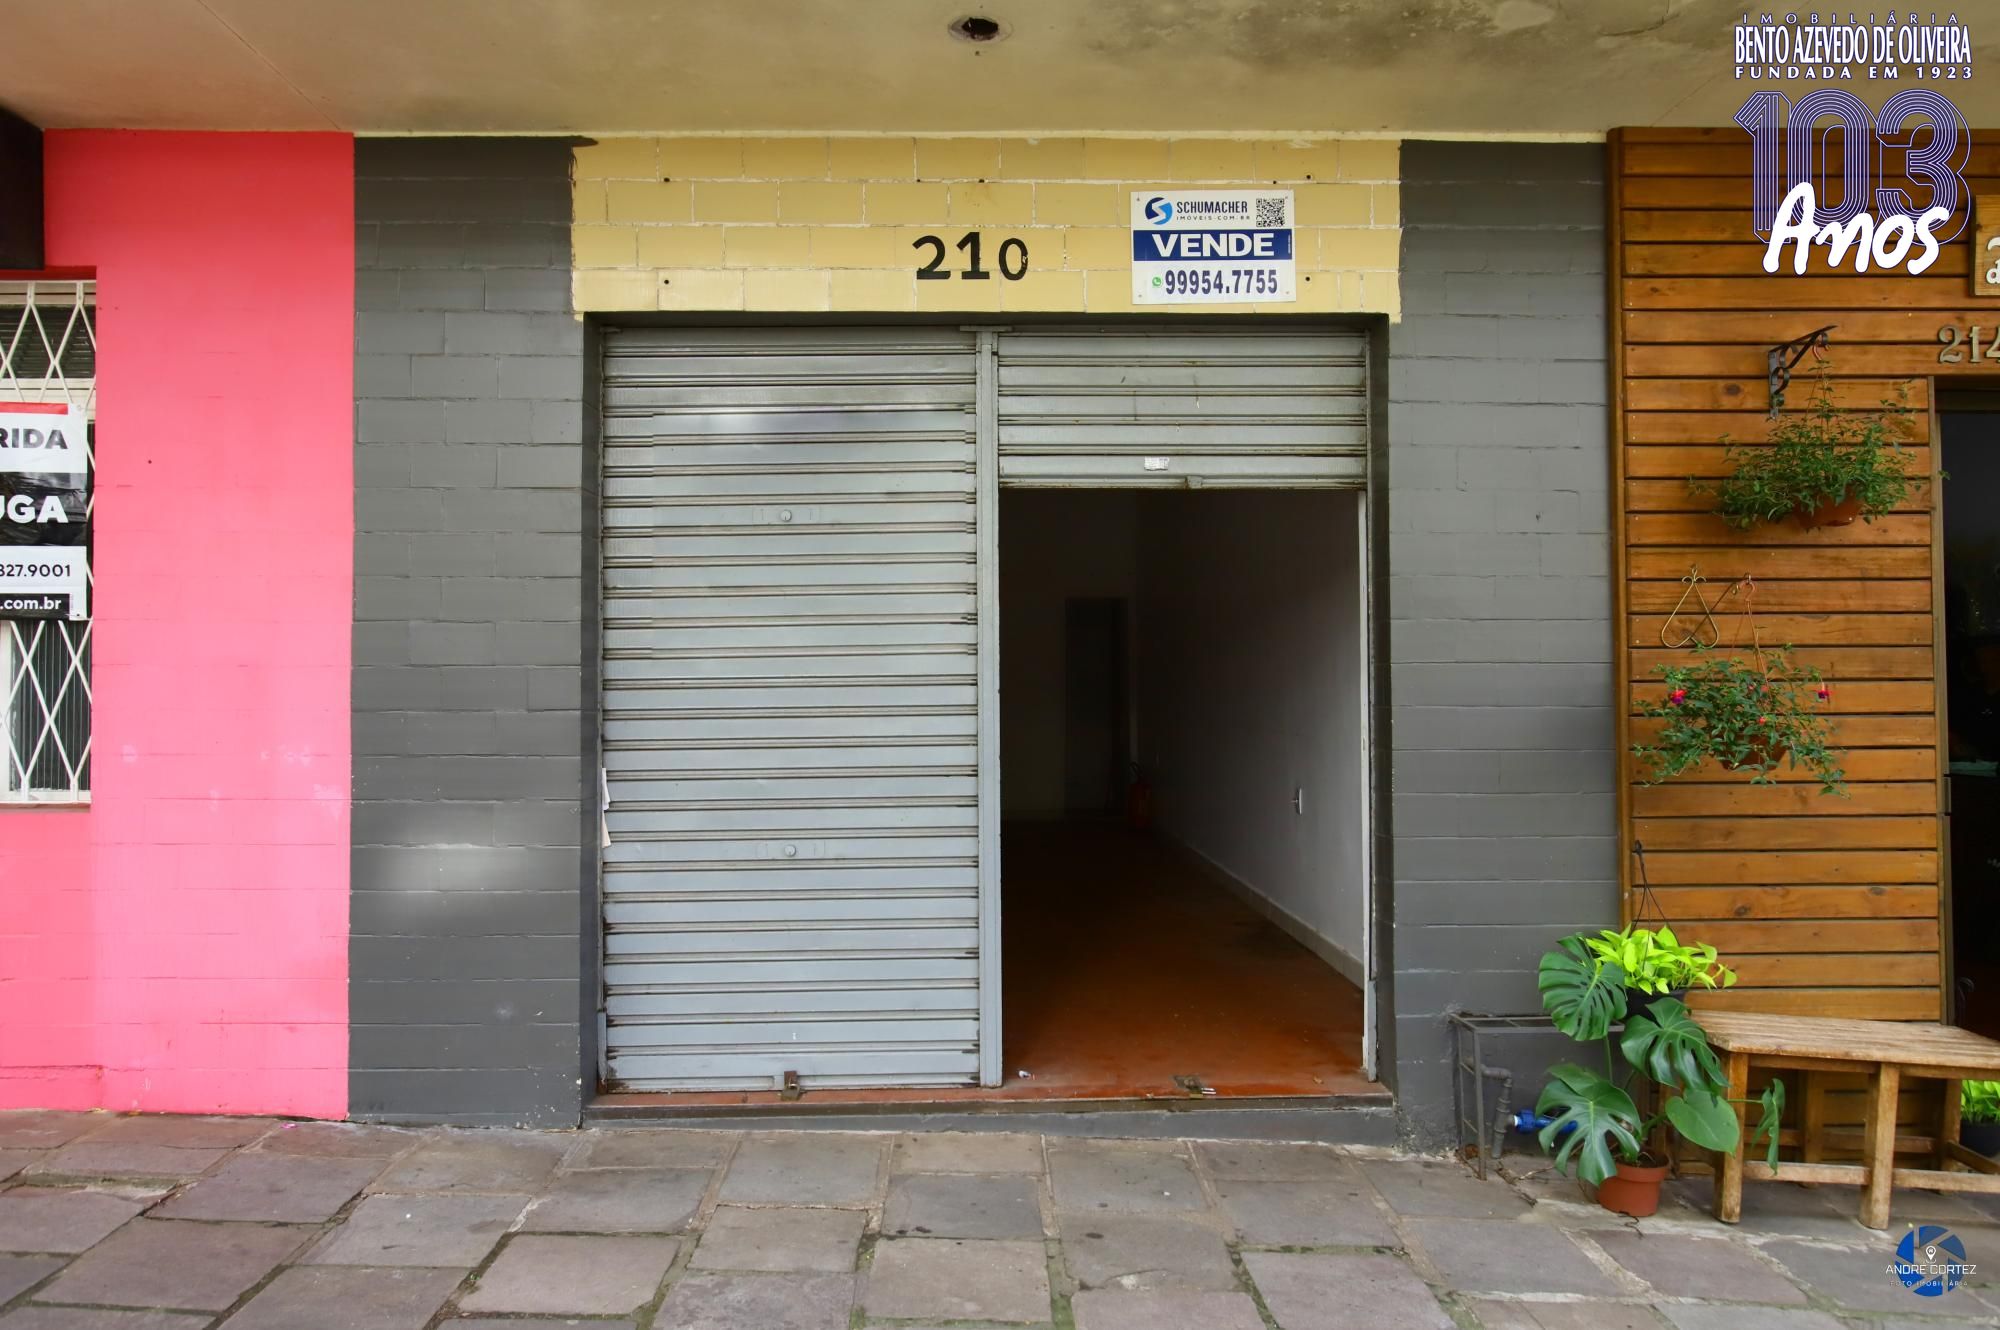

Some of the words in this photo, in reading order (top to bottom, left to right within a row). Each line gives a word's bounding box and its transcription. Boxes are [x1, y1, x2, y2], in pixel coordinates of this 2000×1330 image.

[1176, 200, 1248, 214] SCHUMACHER
[912, 231, 1029, 281] 210
[1152, 232, 1275, 257] VENDE
[1165, 269, 1278, 295] 99954.7755
[0, 494, 69, 524] GA
